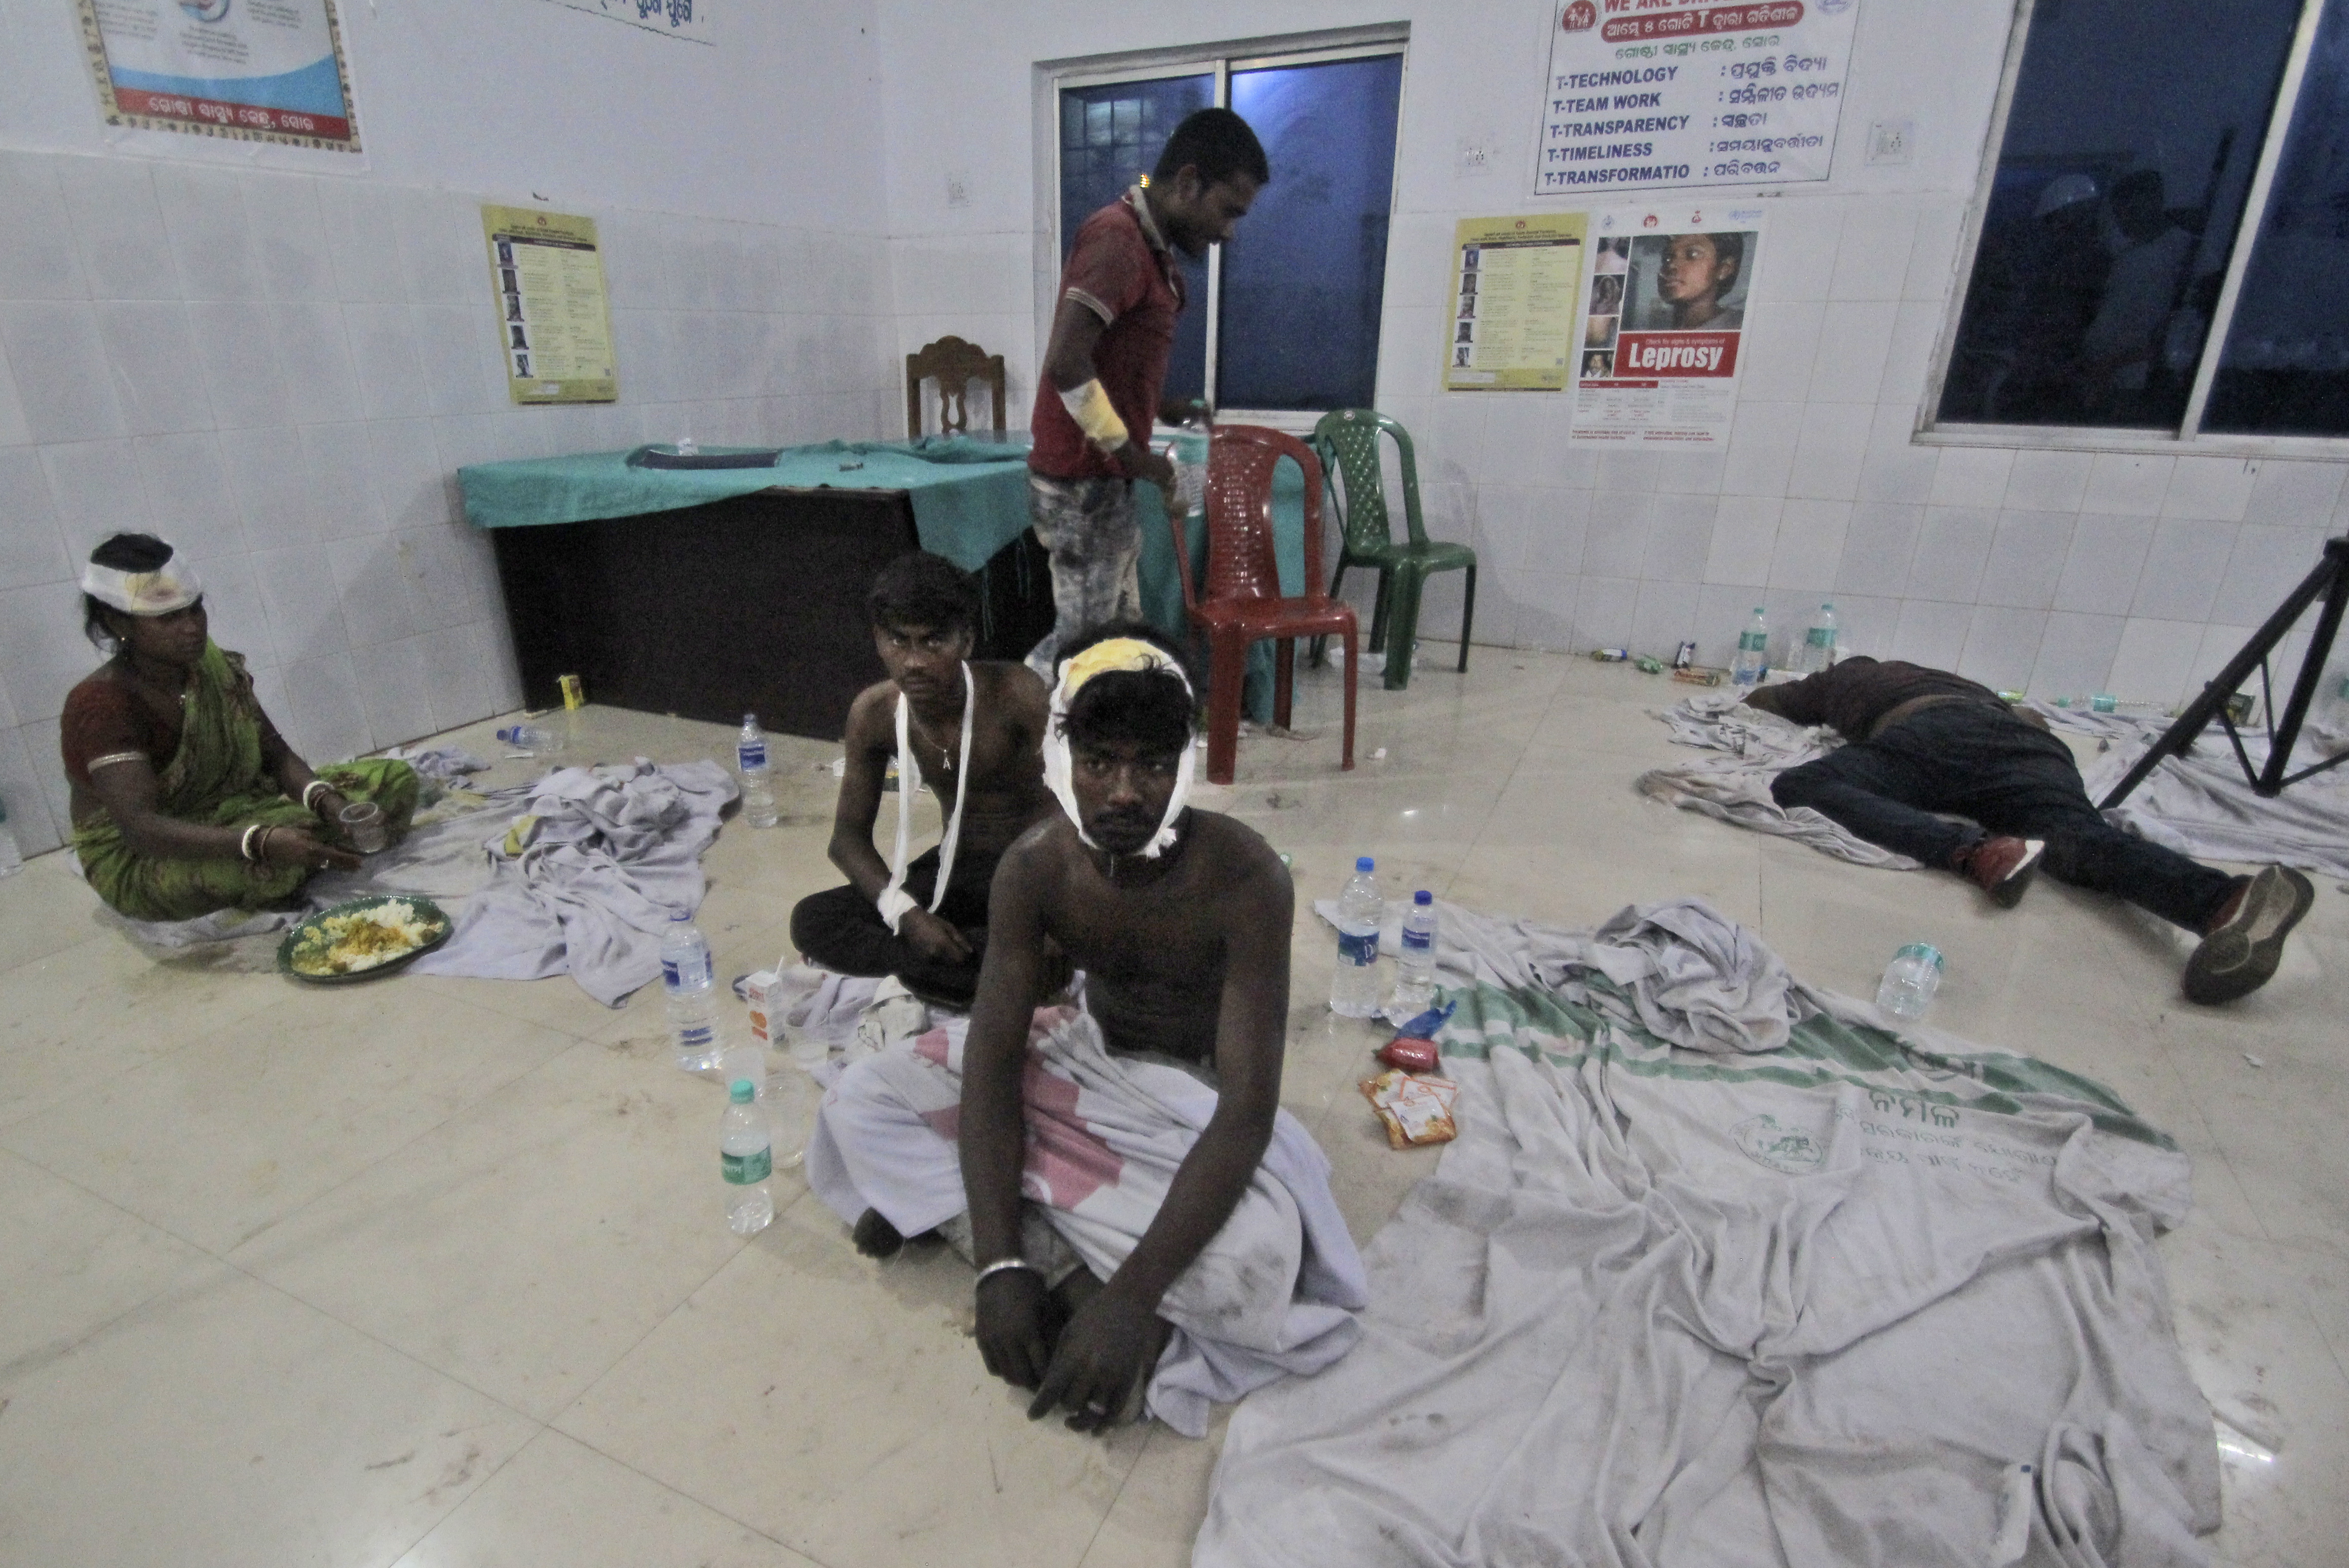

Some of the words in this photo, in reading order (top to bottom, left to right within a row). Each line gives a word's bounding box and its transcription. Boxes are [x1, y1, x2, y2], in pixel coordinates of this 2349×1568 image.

[1605, 0, 1630, 13] WE
[1697, 10, 1710, 27] T
[1556, 66, 1679, 90] T-TECHNOLOGY
[1552, 97, 1609, 114] T-TEAM
[1613, 92, 1662, 110] WORK
[1550, 114, 1690, 138] T-TRANSPARENCY
[1547, 142, 1653, 162] T-TIMELINESS
[1544, 164, 1690, 186] T-TRANSFORMATIO
[1628, 342, 1724, 371] Leprosy
